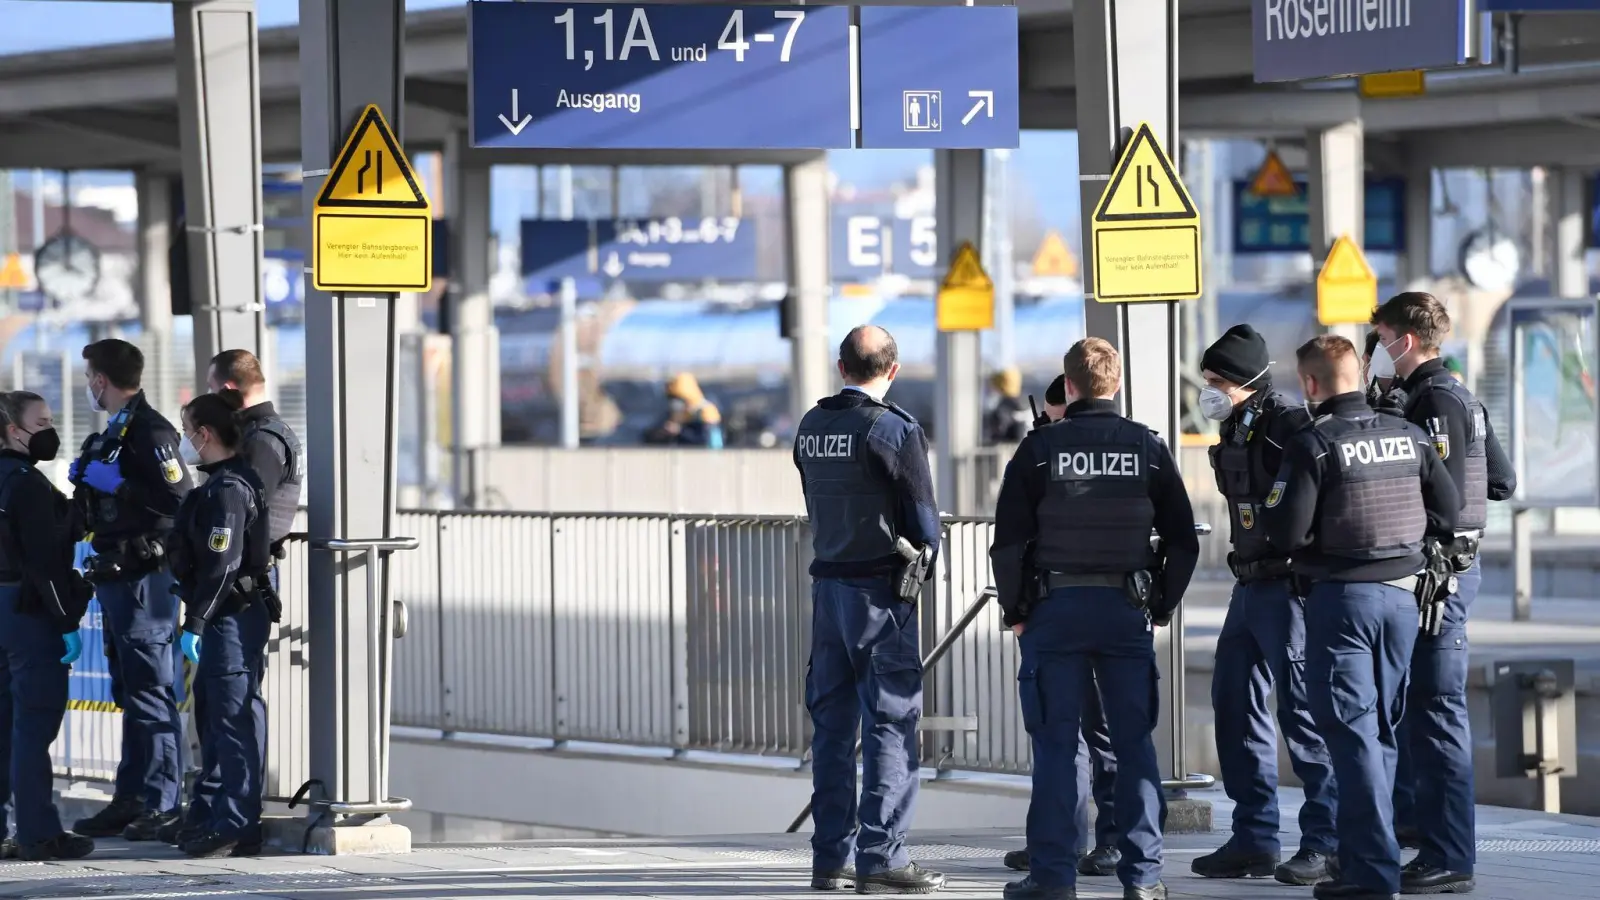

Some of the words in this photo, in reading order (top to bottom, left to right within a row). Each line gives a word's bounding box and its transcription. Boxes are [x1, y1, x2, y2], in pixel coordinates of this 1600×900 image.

[554, 8, 660, 71] 1,1A
[671, 43, 707, 62] und
[717, 9, 806, 63] 4-7
[556, 89, 641, 113] Ausgang
[327, 242, 360, 251] Verengter
[848, 216, 880, 266] E
[911, 216, 937, 266] 5
[354, 252, 368, 260] kein
[799, 434, 852, 458] POLIZEI
[1341, 436, 1416, 466] POLIZEI
[1058, 451, 1140, 476] POLIZEI
